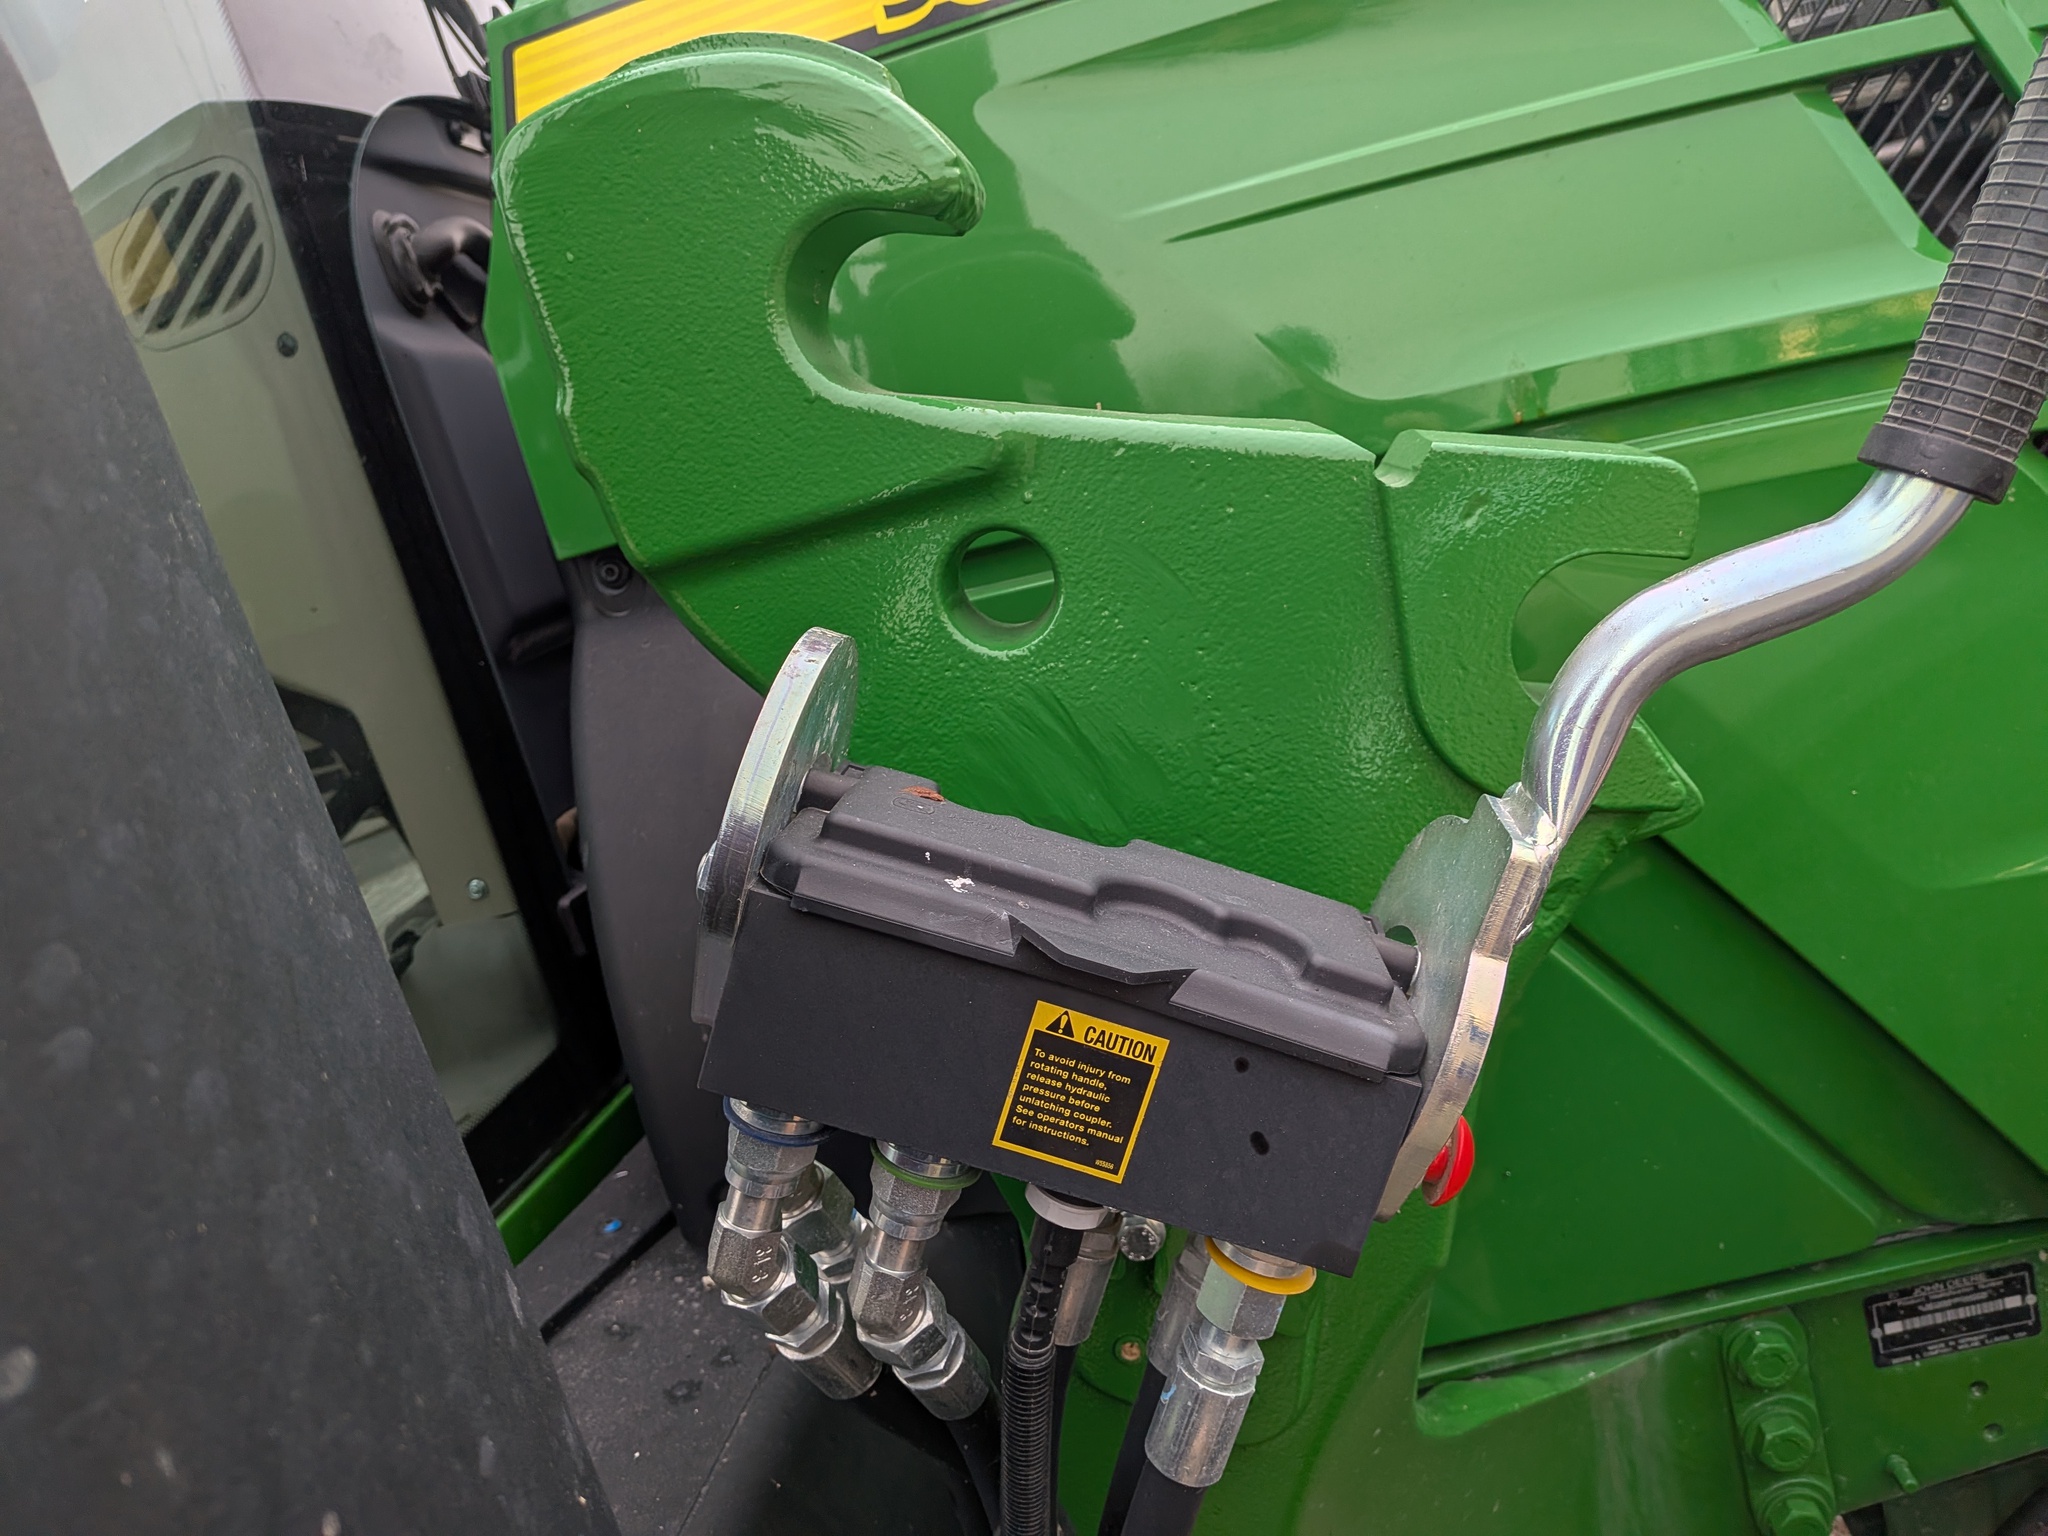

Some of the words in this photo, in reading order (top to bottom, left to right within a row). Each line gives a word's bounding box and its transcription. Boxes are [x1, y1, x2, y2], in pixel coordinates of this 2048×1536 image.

[1083, 1026, 1157, 1063] CAUTION
[1030, 1061, 1069, 1079] rotating
[1071, 1072, 1107, 1090] handle,
[1034, 1047, 1046, 1058] To
[1048, 1053, 1076, 1067] avoid
[1077, 1062, 1105, 1077] injury
[1108, 1070, 1131, 1084] from
[1022, 1083, 1066, 1102] pressure
[1068, 1096, 1100, 1112] before
[1026, 1072, 1063, 1088] release
[1065, 1083, 1110, 1102] hydraulic
[1015, 1104, 1034, 1116] See
[1037, 1113, 1084, 1132] operators
[1087, 1128, 1123, 1143] manual
[1019, 1095, 1071, 1117] unlatching
[1073, 1111, 1112, 1128] coupler.
[1012, 1115, 1027, 1126] for
[1029, 1122, 1089, 1146] instructions.
